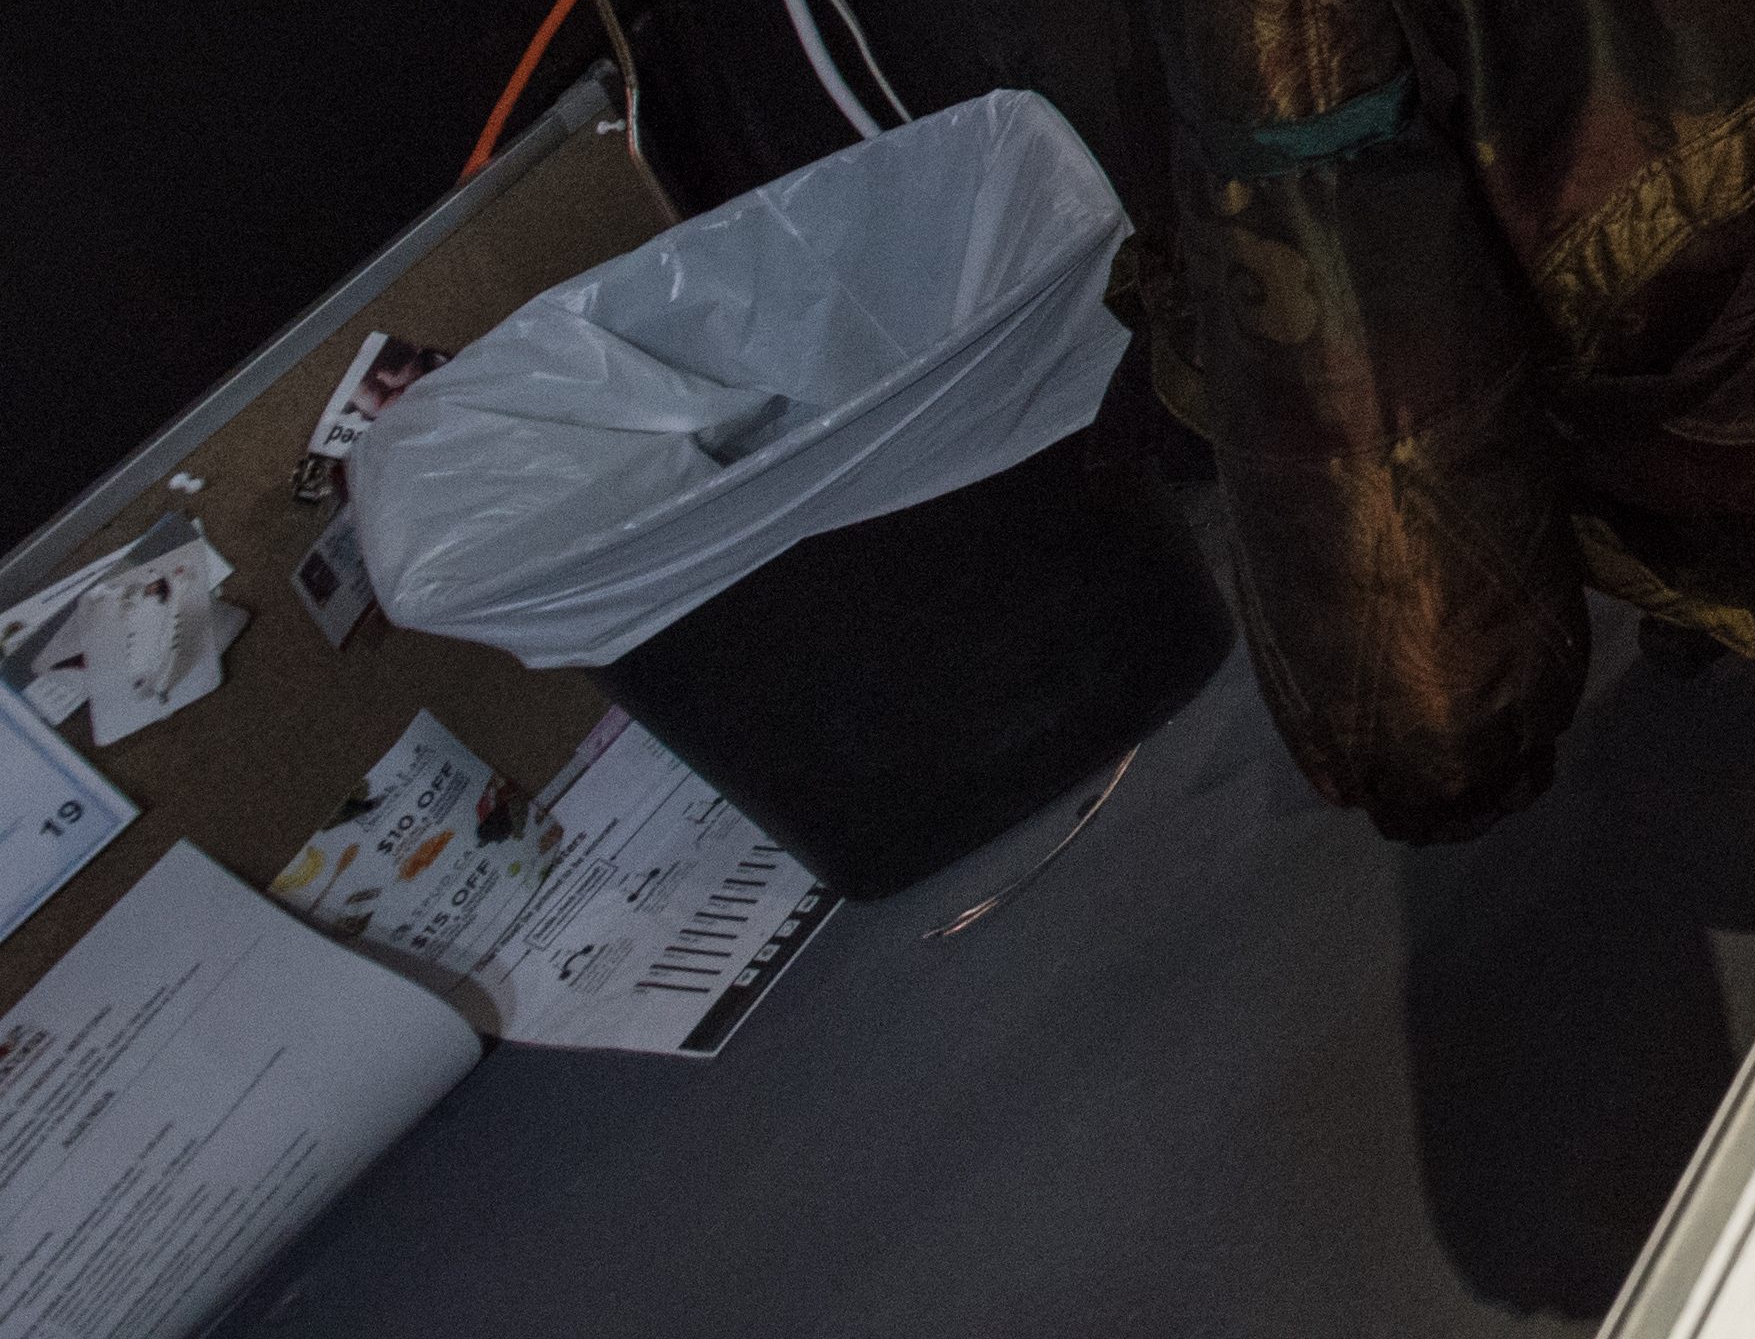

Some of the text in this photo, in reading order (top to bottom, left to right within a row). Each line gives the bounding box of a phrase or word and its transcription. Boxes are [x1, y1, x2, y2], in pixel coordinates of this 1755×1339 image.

[39, 799, 84, 838] 19
[377, 814, 414, 855] $10
[417, 761, 452, 809] OFF
[411, 911, 449, 949] $15
[451, 859, 490, 907] OFF
